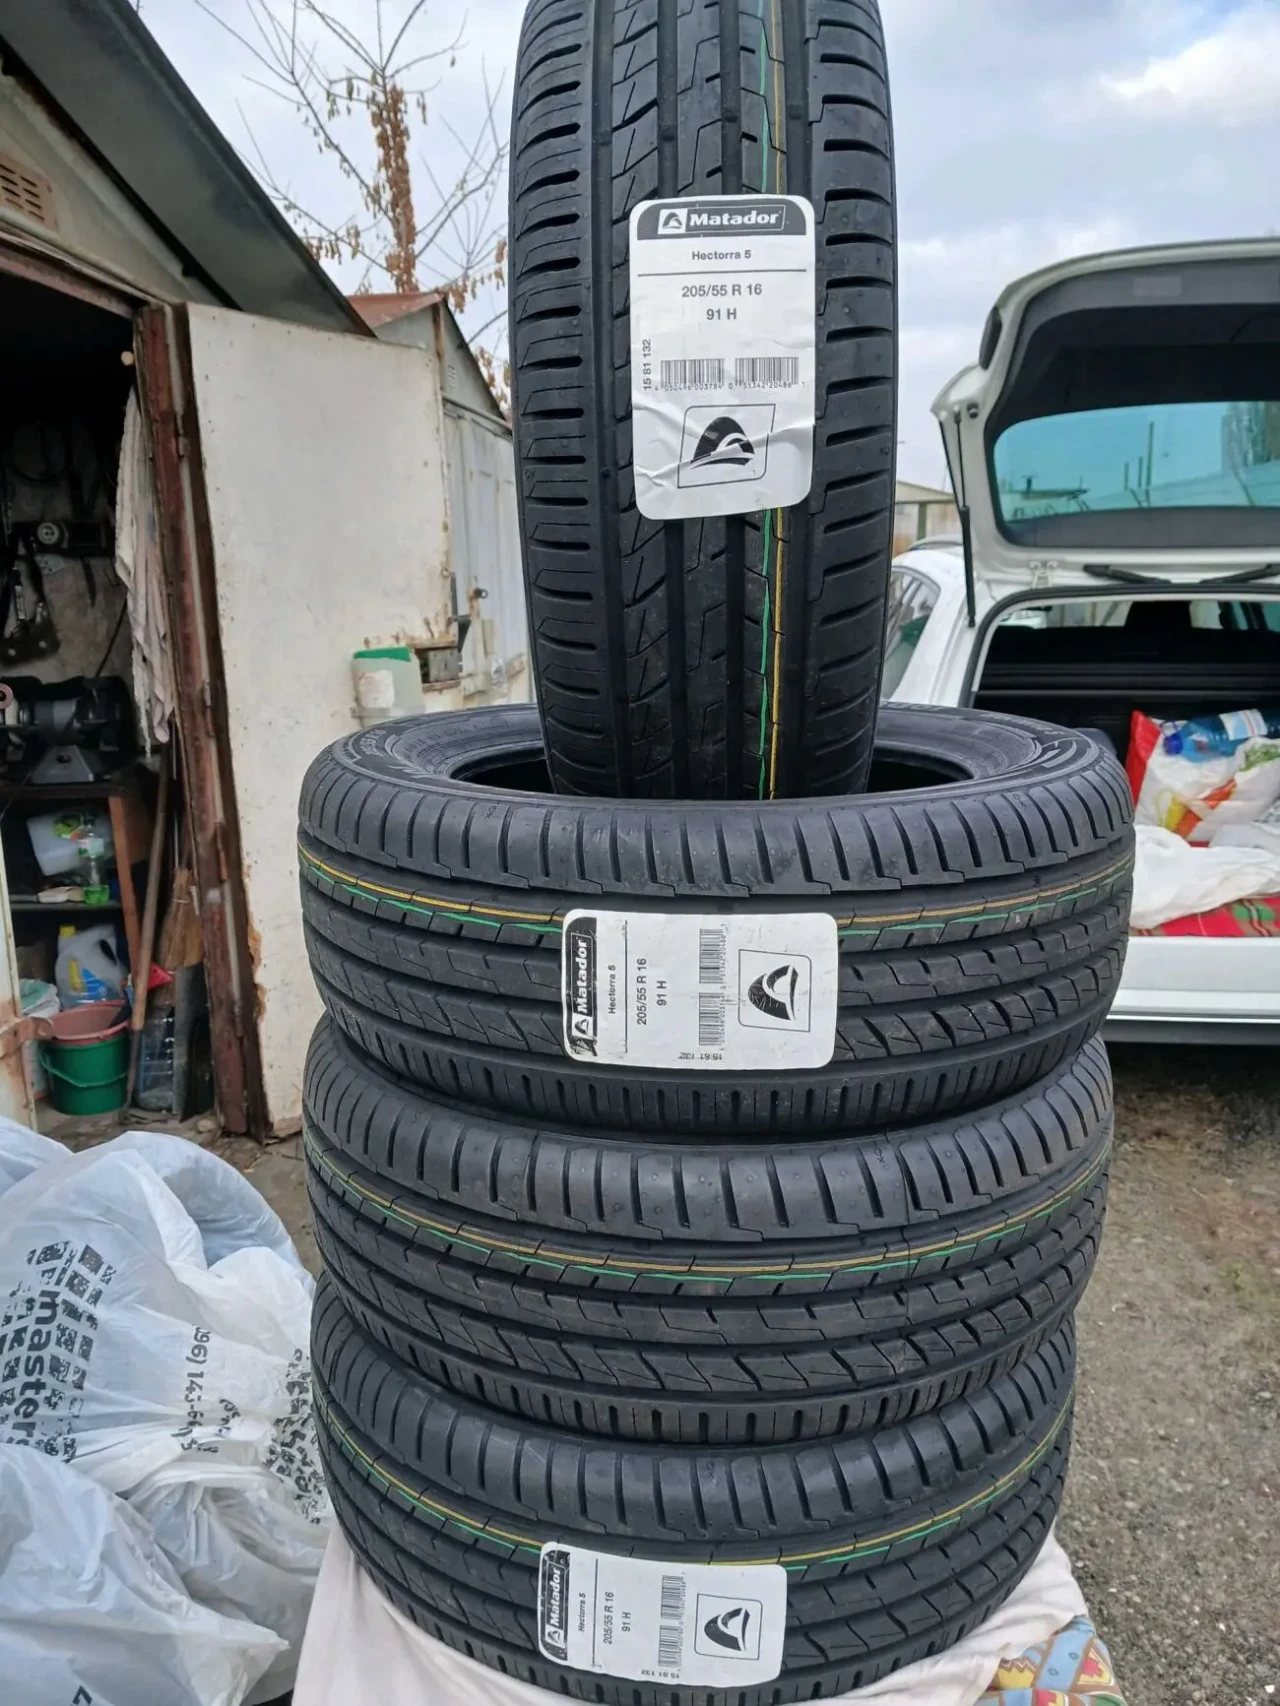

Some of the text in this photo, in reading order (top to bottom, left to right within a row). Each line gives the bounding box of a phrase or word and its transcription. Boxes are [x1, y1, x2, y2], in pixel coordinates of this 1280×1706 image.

[689, 210, 779, 227] Matador
[691, 249, 751, 261] Hectorra 5
[681, 283, 762, 298] 205/55 R 16
[705, 307, 737, 320] 91 H
[642, 338, 652, 391] 15 81 132
[576, 939, 588, 1013] Matador
[607, 972, 616, 1014] Hectorra
[636, 958, 647, 1026] 205/55 R 16
[656, 980, 667, 1006] 91 H
[549, 1568, 560, 1628] Matador
[604, 1591, 614, 1645] 205/55 R 16
[621, 1611, 631, 1632] 91 H
